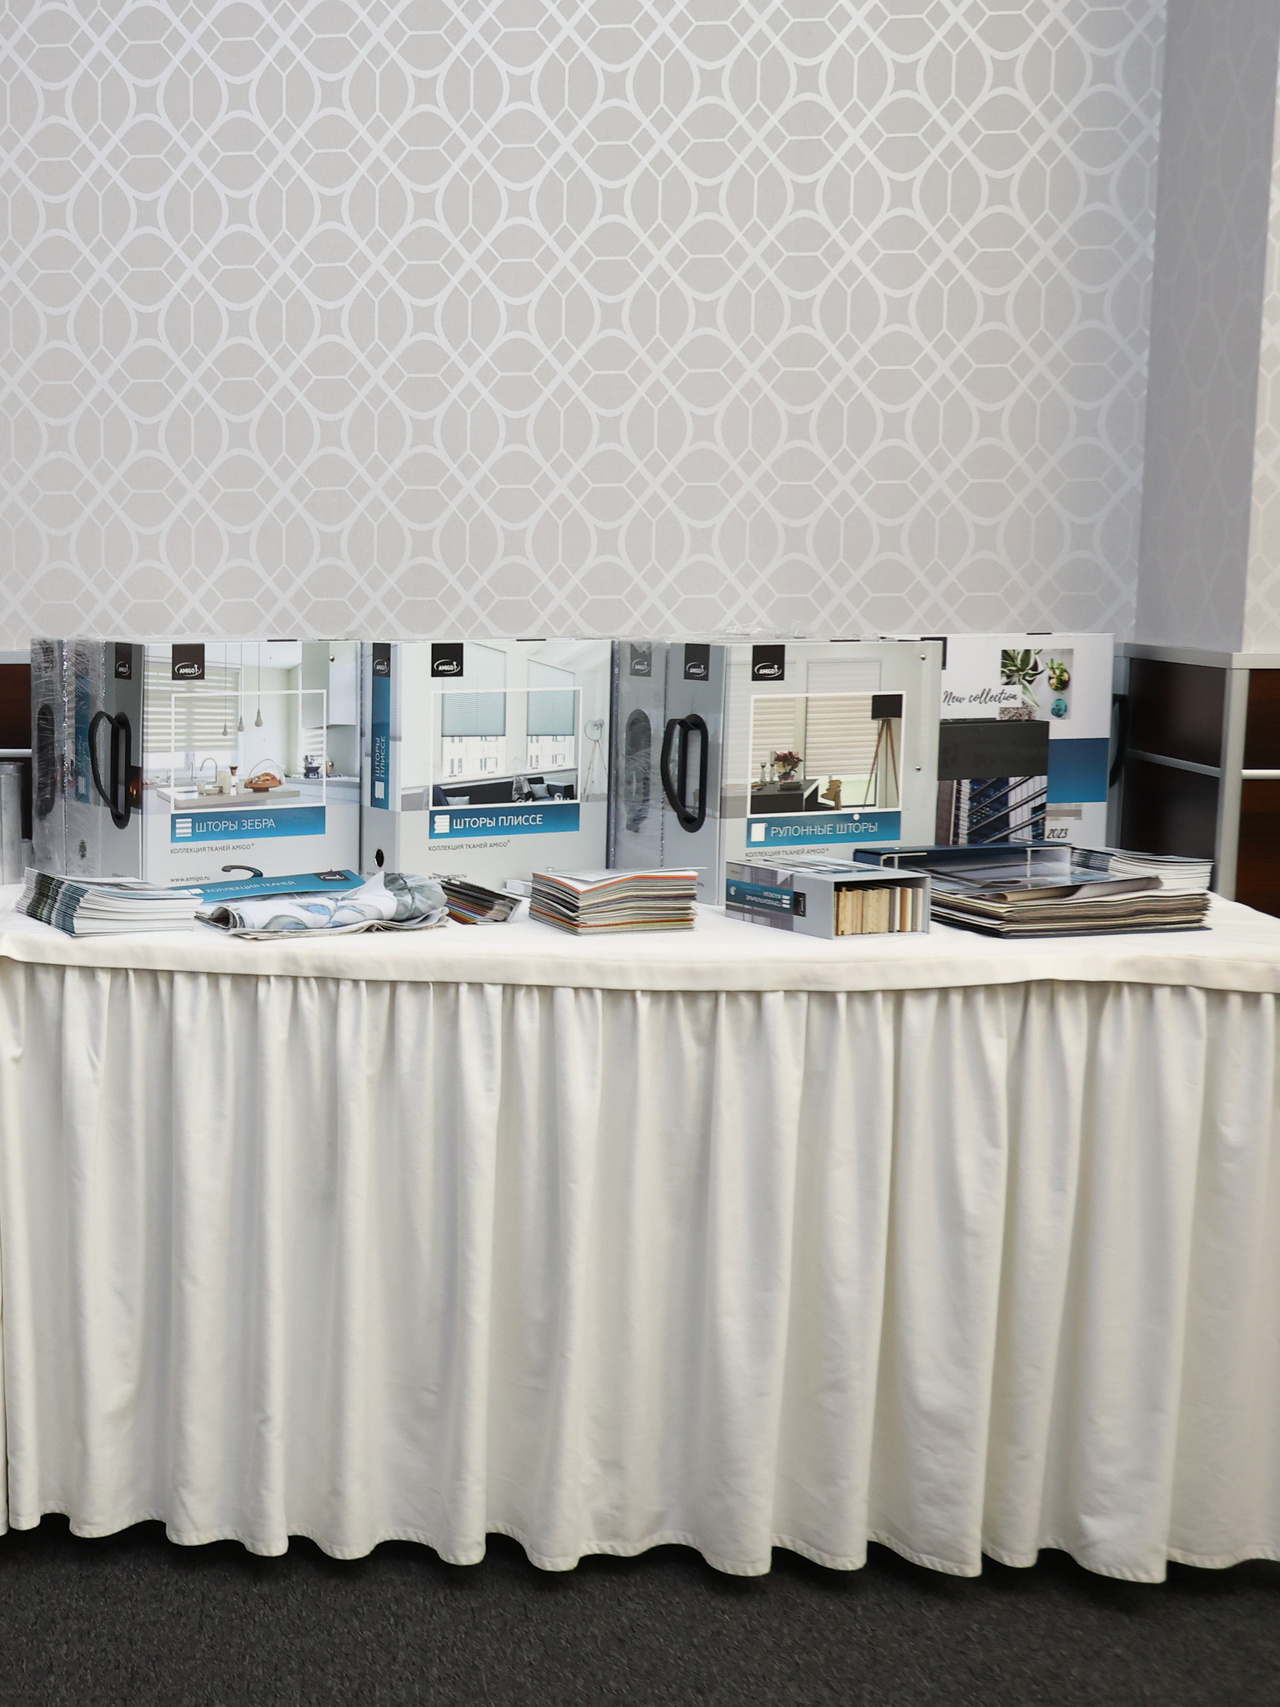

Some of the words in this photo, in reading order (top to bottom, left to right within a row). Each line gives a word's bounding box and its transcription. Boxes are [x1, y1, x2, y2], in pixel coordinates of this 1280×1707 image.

[942, 690, 966, 706] New
[968, 688, 1018, 704] collection
[195, 820, 238, 833] ШТОРЫ
[241, 818, 276, 830] ЗЕБРА
[452, 817, 496, 829] ШТОРЫ
[499, 814, 543, 827] ПЛИССЕ
[770, 823, 834, 837] РУЛОННЫЕ
[836, 822, 878, 834] ШТОРЫ
[1046, 828, 1068, 839] 2023
[170, 846, 206, 854] КОЛЛЕКЦИЯ
[207, 844, 231, 852] ТКАНЕЙ
[428, 843, 464, 852] КОЛЛЕКЦИЯ
[465, 841, 488, 849] ТКАНЕЙ
[745, 850, 781, 858] КОЛЛЕКЦИЯ
[781, 848, 805, 856] ТКАНЕЙ
[170, 875, 210, 883] www.amigo.ru
[205, 883, 260, 893] КОЛЛЕКЦИЯ
[261, 880, 296, 888] ТКАНЕЙ
